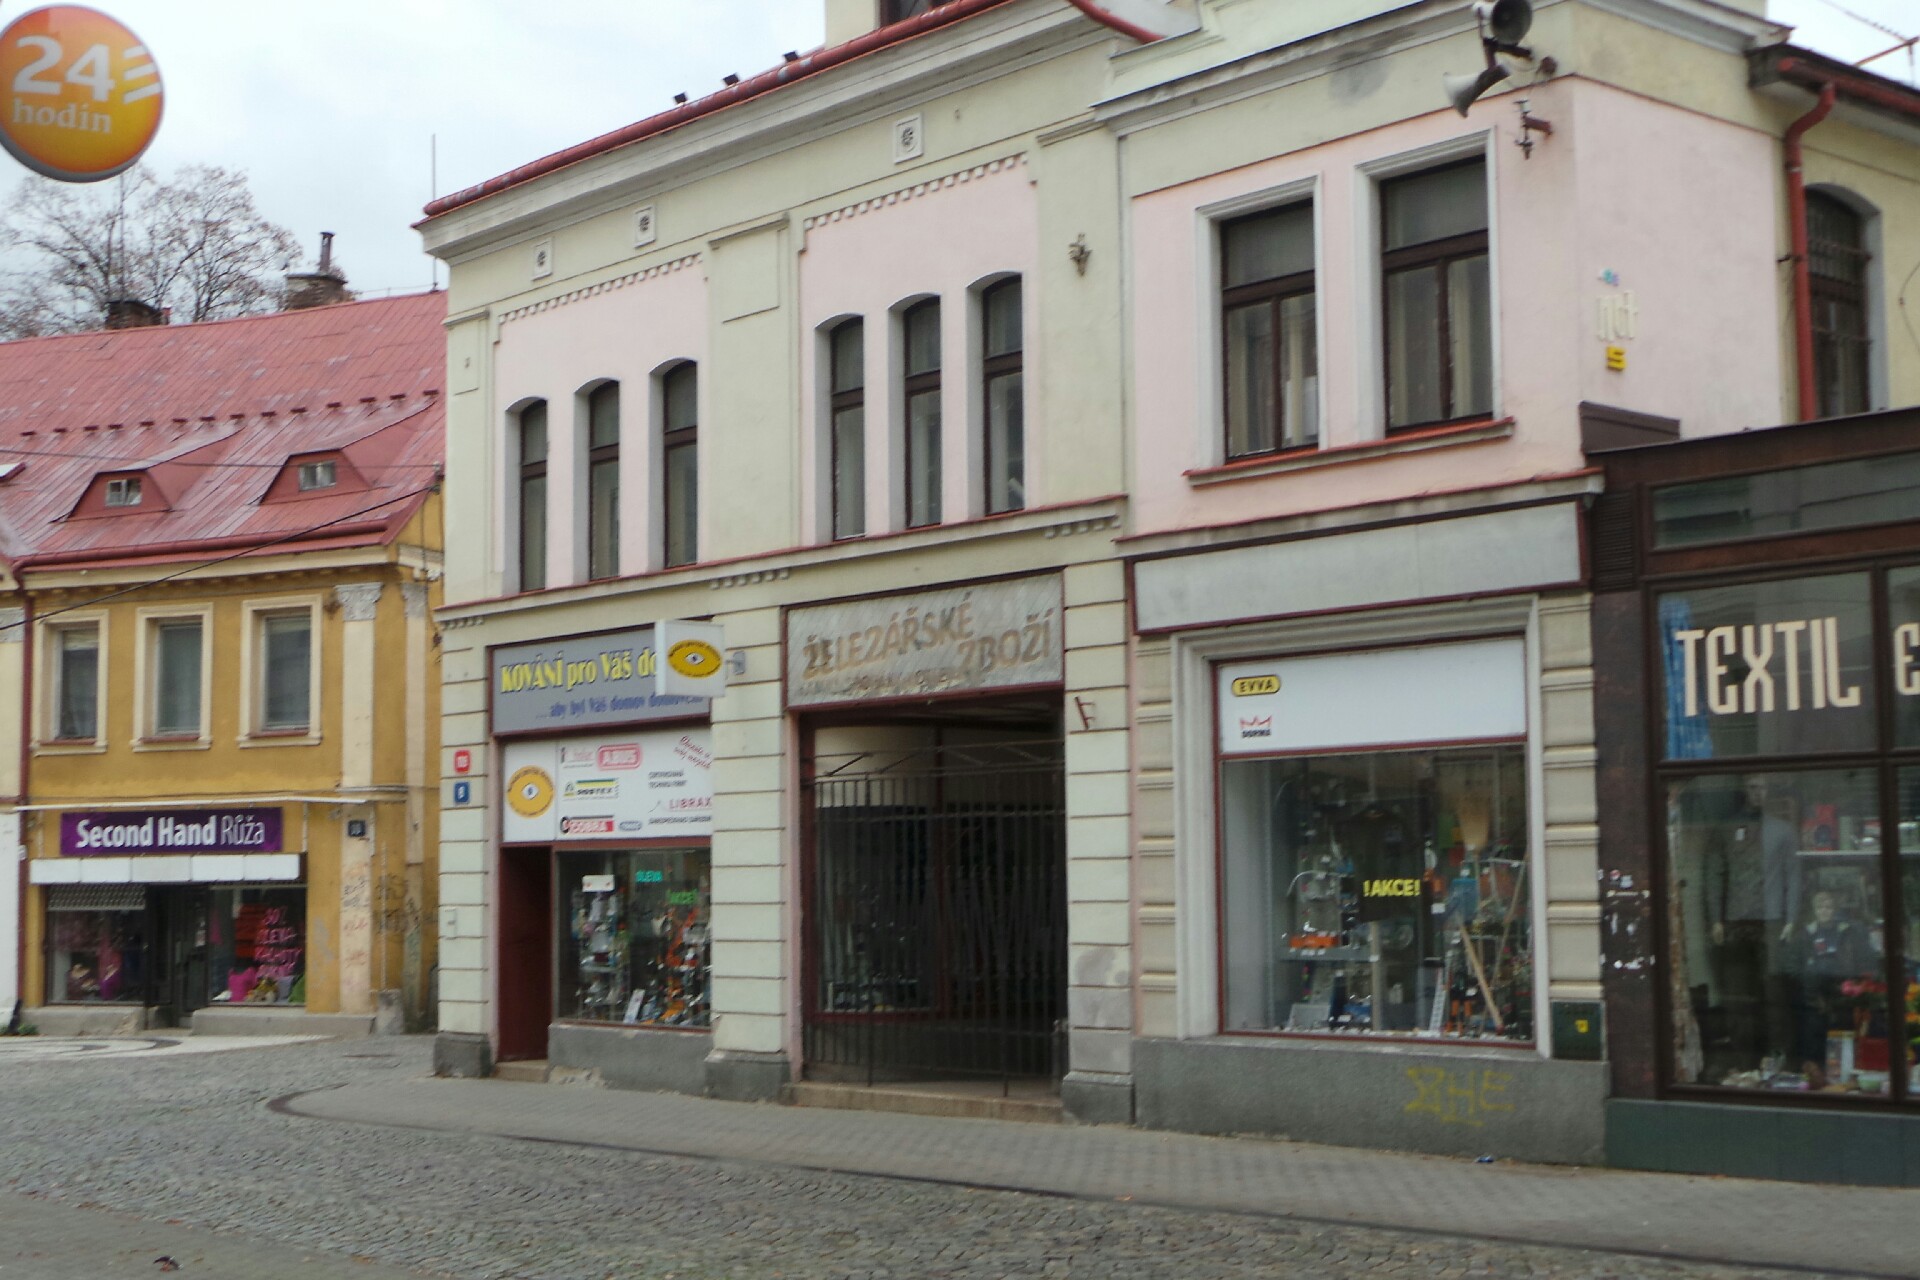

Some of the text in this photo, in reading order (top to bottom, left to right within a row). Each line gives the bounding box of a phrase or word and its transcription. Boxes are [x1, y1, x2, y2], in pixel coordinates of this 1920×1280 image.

[13, 35, 116, 103] 24
[12, 98, 113, 134] hodin
[803, 591, 974, 680] ŽELEZÁŘSKÉ
[957, 607, 1055, 673] ZBOŽÍ
[1674, 616, 1861, 717] TEXTIL
[501, 651, 564, 693] KOVÁNÍ
[565, 659, 598, 692] pro
[599, 648, 634, 683] Váš
[75, 813, 266, 848] Second Hand Růža
